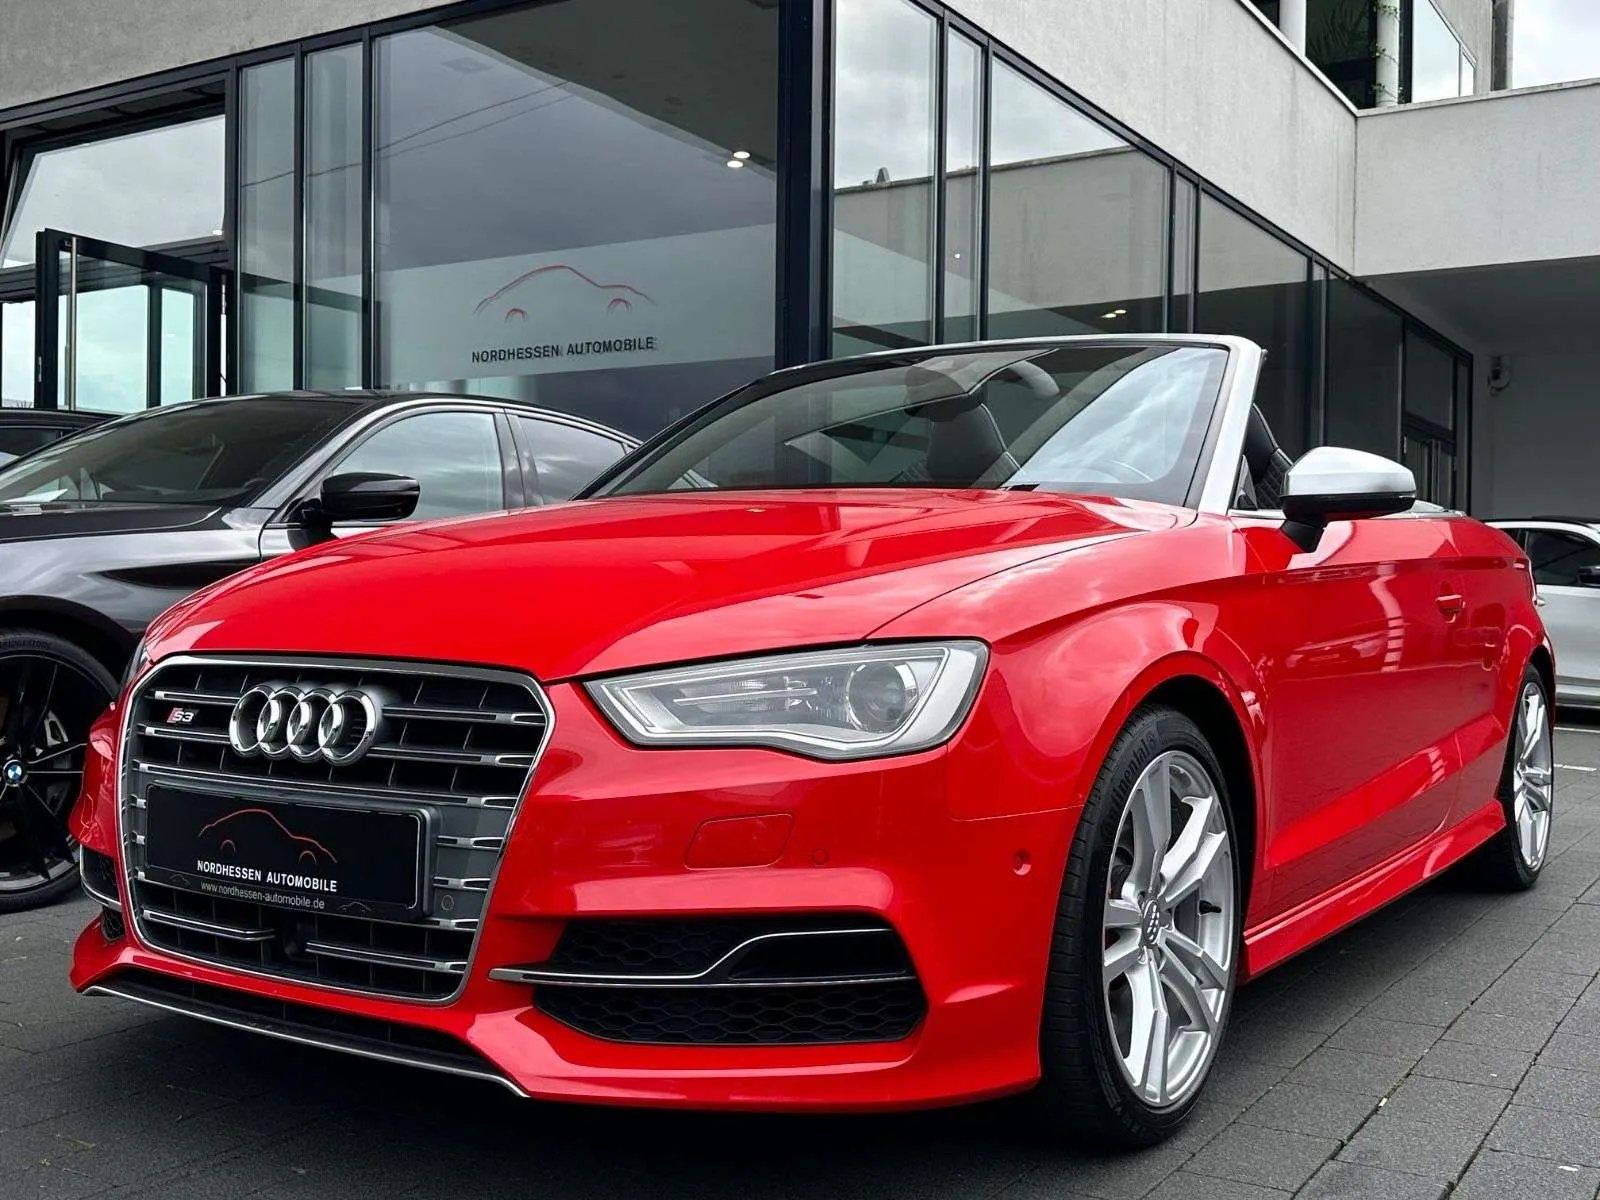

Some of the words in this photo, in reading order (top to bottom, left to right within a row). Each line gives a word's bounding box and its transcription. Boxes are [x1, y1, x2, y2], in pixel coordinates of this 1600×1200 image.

[471, 345, 560, 363] NORDHESSEN
[567, 337, 655, 355] AUTOMOBILE
[169, 708, 196, 723] S3
[197, 859, 262, 882] NORDHESSEN
[266, 871, 337, 892] AUTOMOBILE
[201, 881, 325, 909] www.nordhessen-automobile.de
